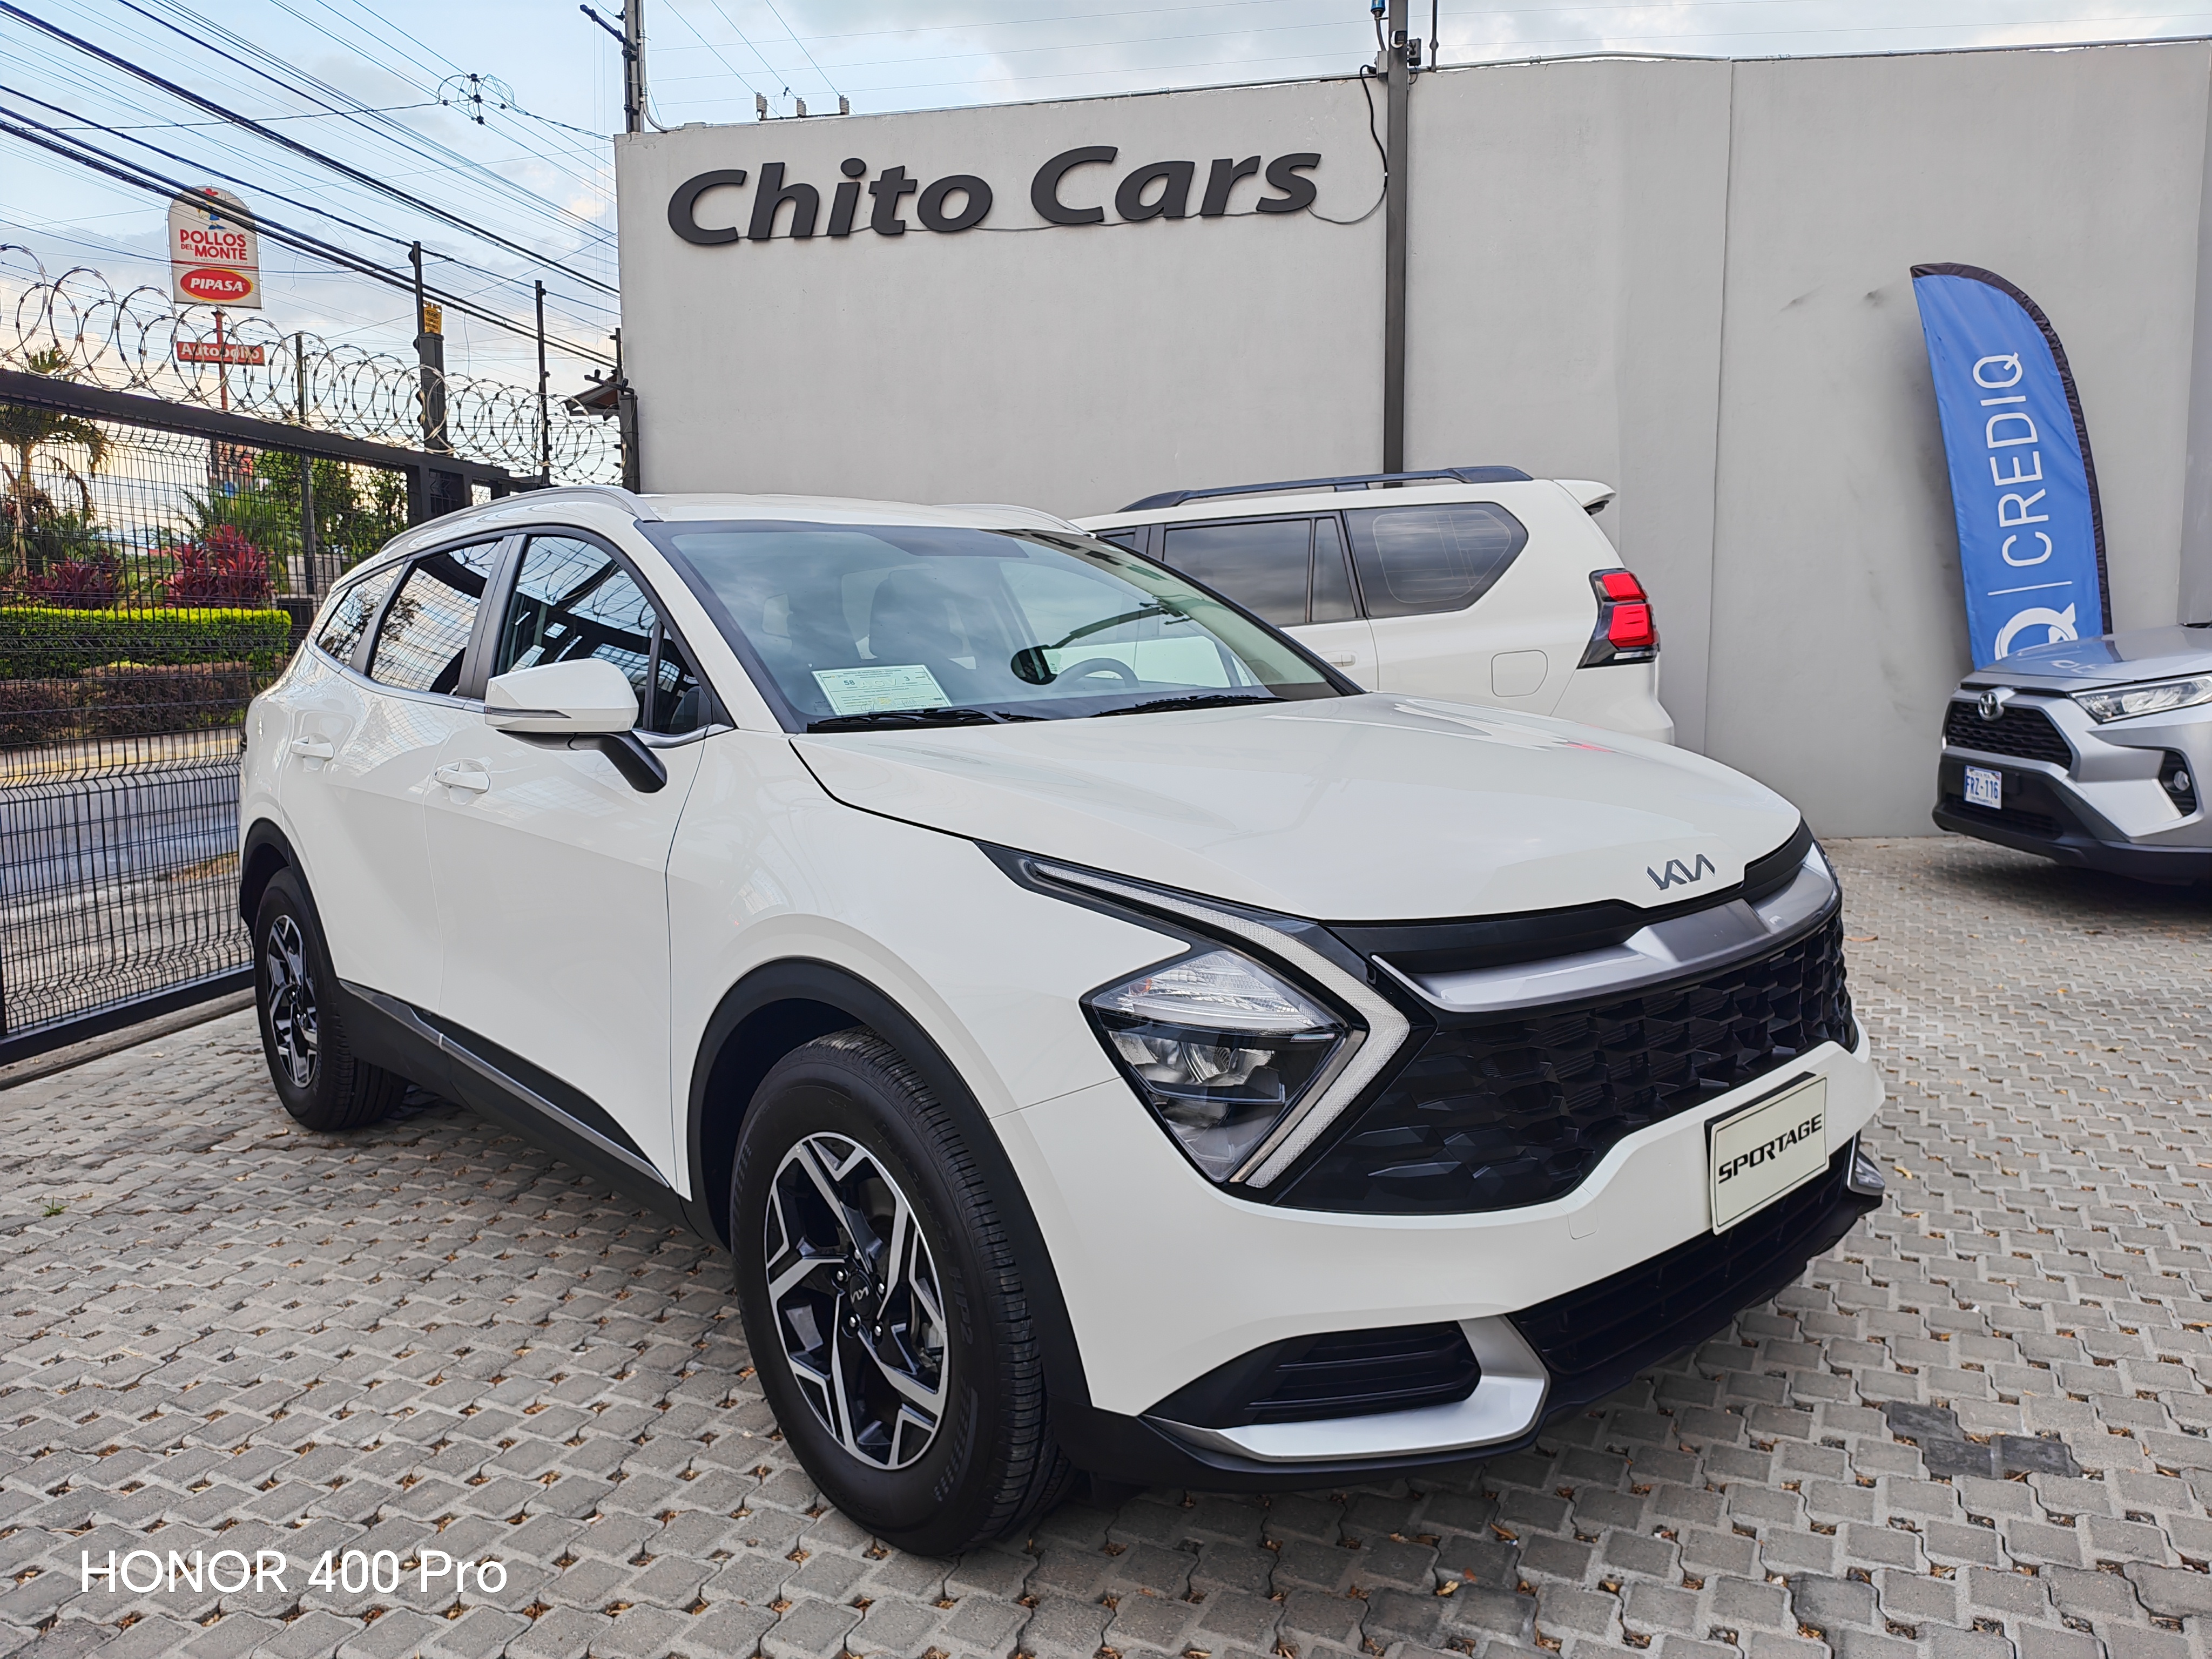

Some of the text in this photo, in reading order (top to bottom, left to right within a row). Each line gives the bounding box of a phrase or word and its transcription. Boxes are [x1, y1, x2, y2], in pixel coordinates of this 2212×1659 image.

[667, 145, 1321, 245] Chito Cars
[180, 229, 247, 247] POLLOS
[194, 246, 248, 261] MONTE
[190, 278, 244, 292] PIPASA
[181, 343, 260, 359] Autopollo
[1972, 352, 2052, 567] CREDIQ
[1966, 775, 1998, 799] FRZ-116
[1645, 853, 1715, 891] KIA
[1718, 1112, 1822, 1184] SPORTAGE
